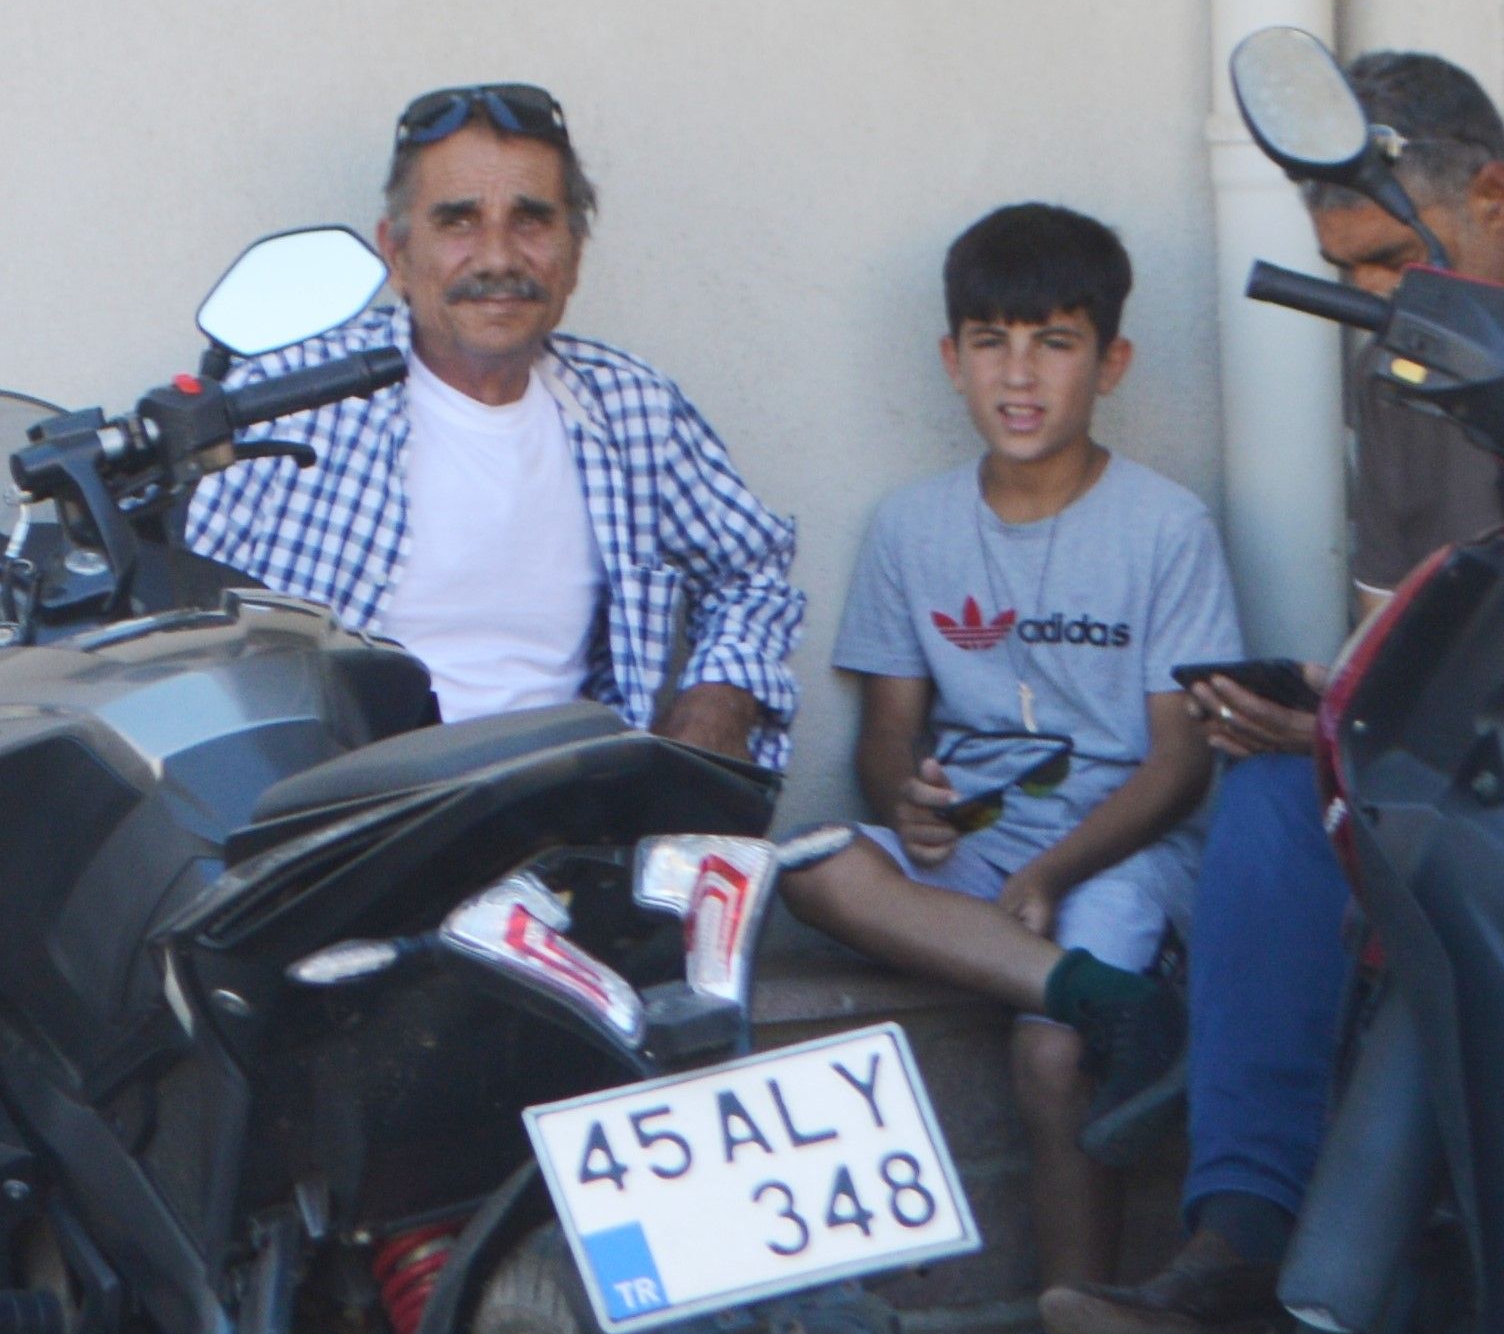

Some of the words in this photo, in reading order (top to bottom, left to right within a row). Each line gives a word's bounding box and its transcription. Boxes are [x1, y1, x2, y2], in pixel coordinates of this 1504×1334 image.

[1018, 612, 1131, 647] adidas
[577, 1104, 693, 1193] 45
[715, 1053, 887, 1164] ALY
[753, 1151, 937, 1257] 348
[614, 1276, 660, 1312] TR
